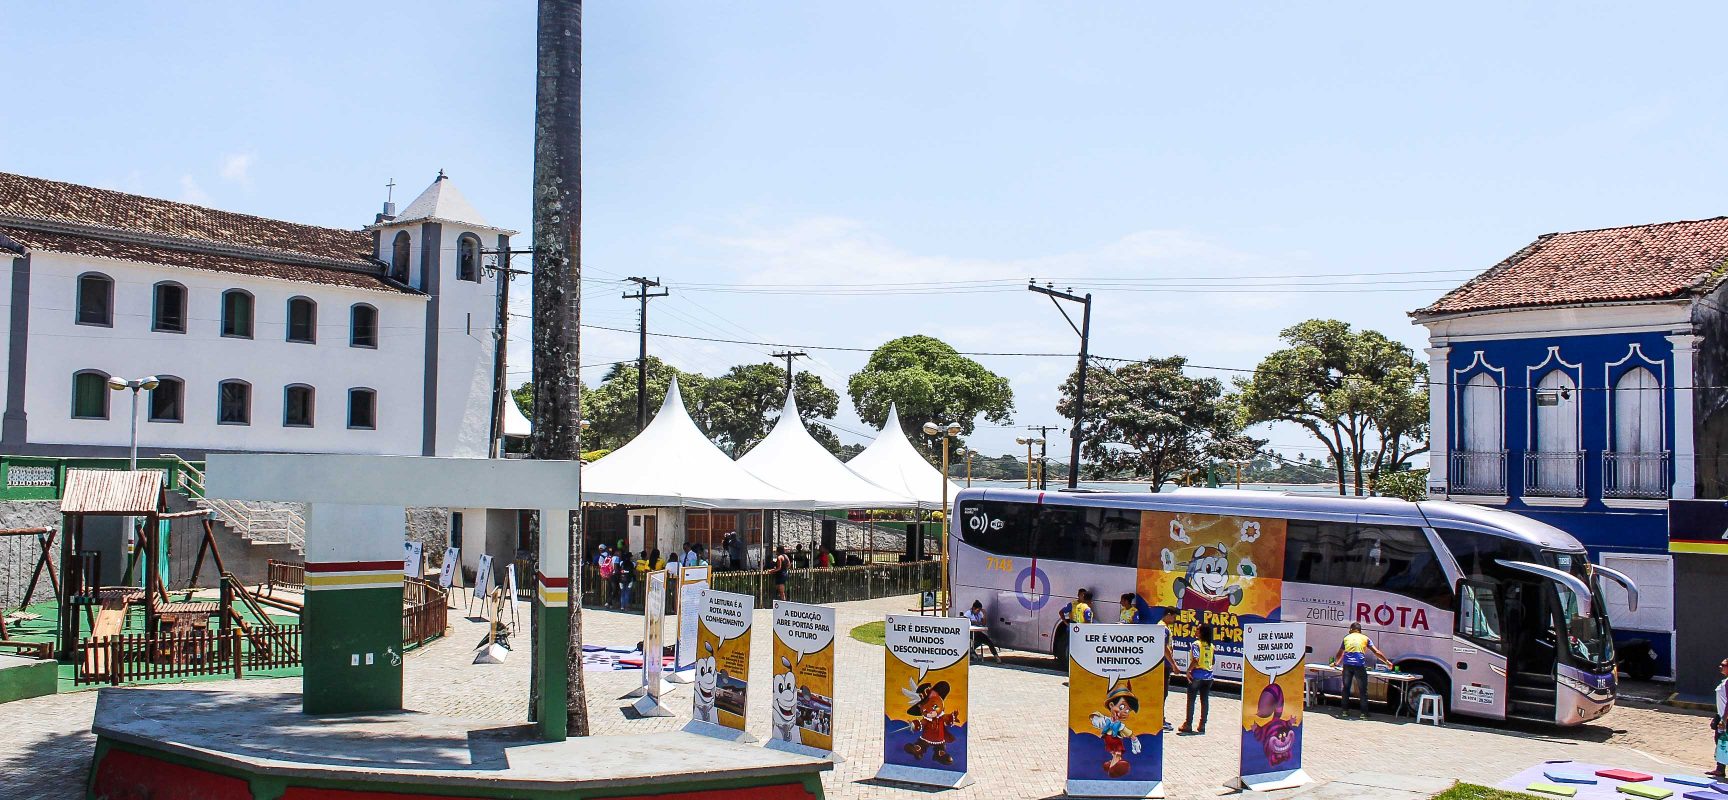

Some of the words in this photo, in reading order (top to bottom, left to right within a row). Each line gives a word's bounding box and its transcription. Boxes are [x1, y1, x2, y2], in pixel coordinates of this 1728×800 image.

[714, 598, 733, 607] LEITURA
[709, 606, 722, 615] ROTA
[723, 609, 736, 617] PARA
[790, 610, 822, 622] EDUCAÇÃO
[1306, 605, 1345, 621] zenitte
[1356, 602, 1429, 630] ROTA
[705, 614, 745, 628] CONHECIMENTO
[1203, 610, 1239, 627] PARA
[776, 618, 791, 627] ABRE
[792, 620, 814, 630] PORTAS
[814, 623, 830, 632] PARA
[893, 624, 907, 632] LER
[908, 622, 913, 632] É
[914, 625, 961, 635] DESVENDAR
[788, 629, 794, 637] O
[795, 630, 818, 640] FUTURO
[908, 635, 944, 645] MUNDOS
[1085, 634, 1100, 643] LER
[1102, 632, 1107, 643] É
[1110, 635, 1134, 643] VOAR
[1136, 635, 1155, 644] POR
[1258, 632, 1268, 640] LER
[1269, 630, 1273, 640] É
[1274, 632, 1294, 640] VIAJAR
[893, 645, 959, 657] DESCONHECIDOS.
[1095, 646, 1144, 654] CAMINHOS
[1257, 643, 1269, 651] SEM
[1270, 643, 1283, 651] SAIR
[1284, 642, 1294, 650] DO
[1096, 656, 1142, 665] INFINITOS.
[1253, 653, 1275, 662] MESMO
[1276, 652, 1296, 660] LUGAR.
[1220, 661, 1242, 671] ROTA
